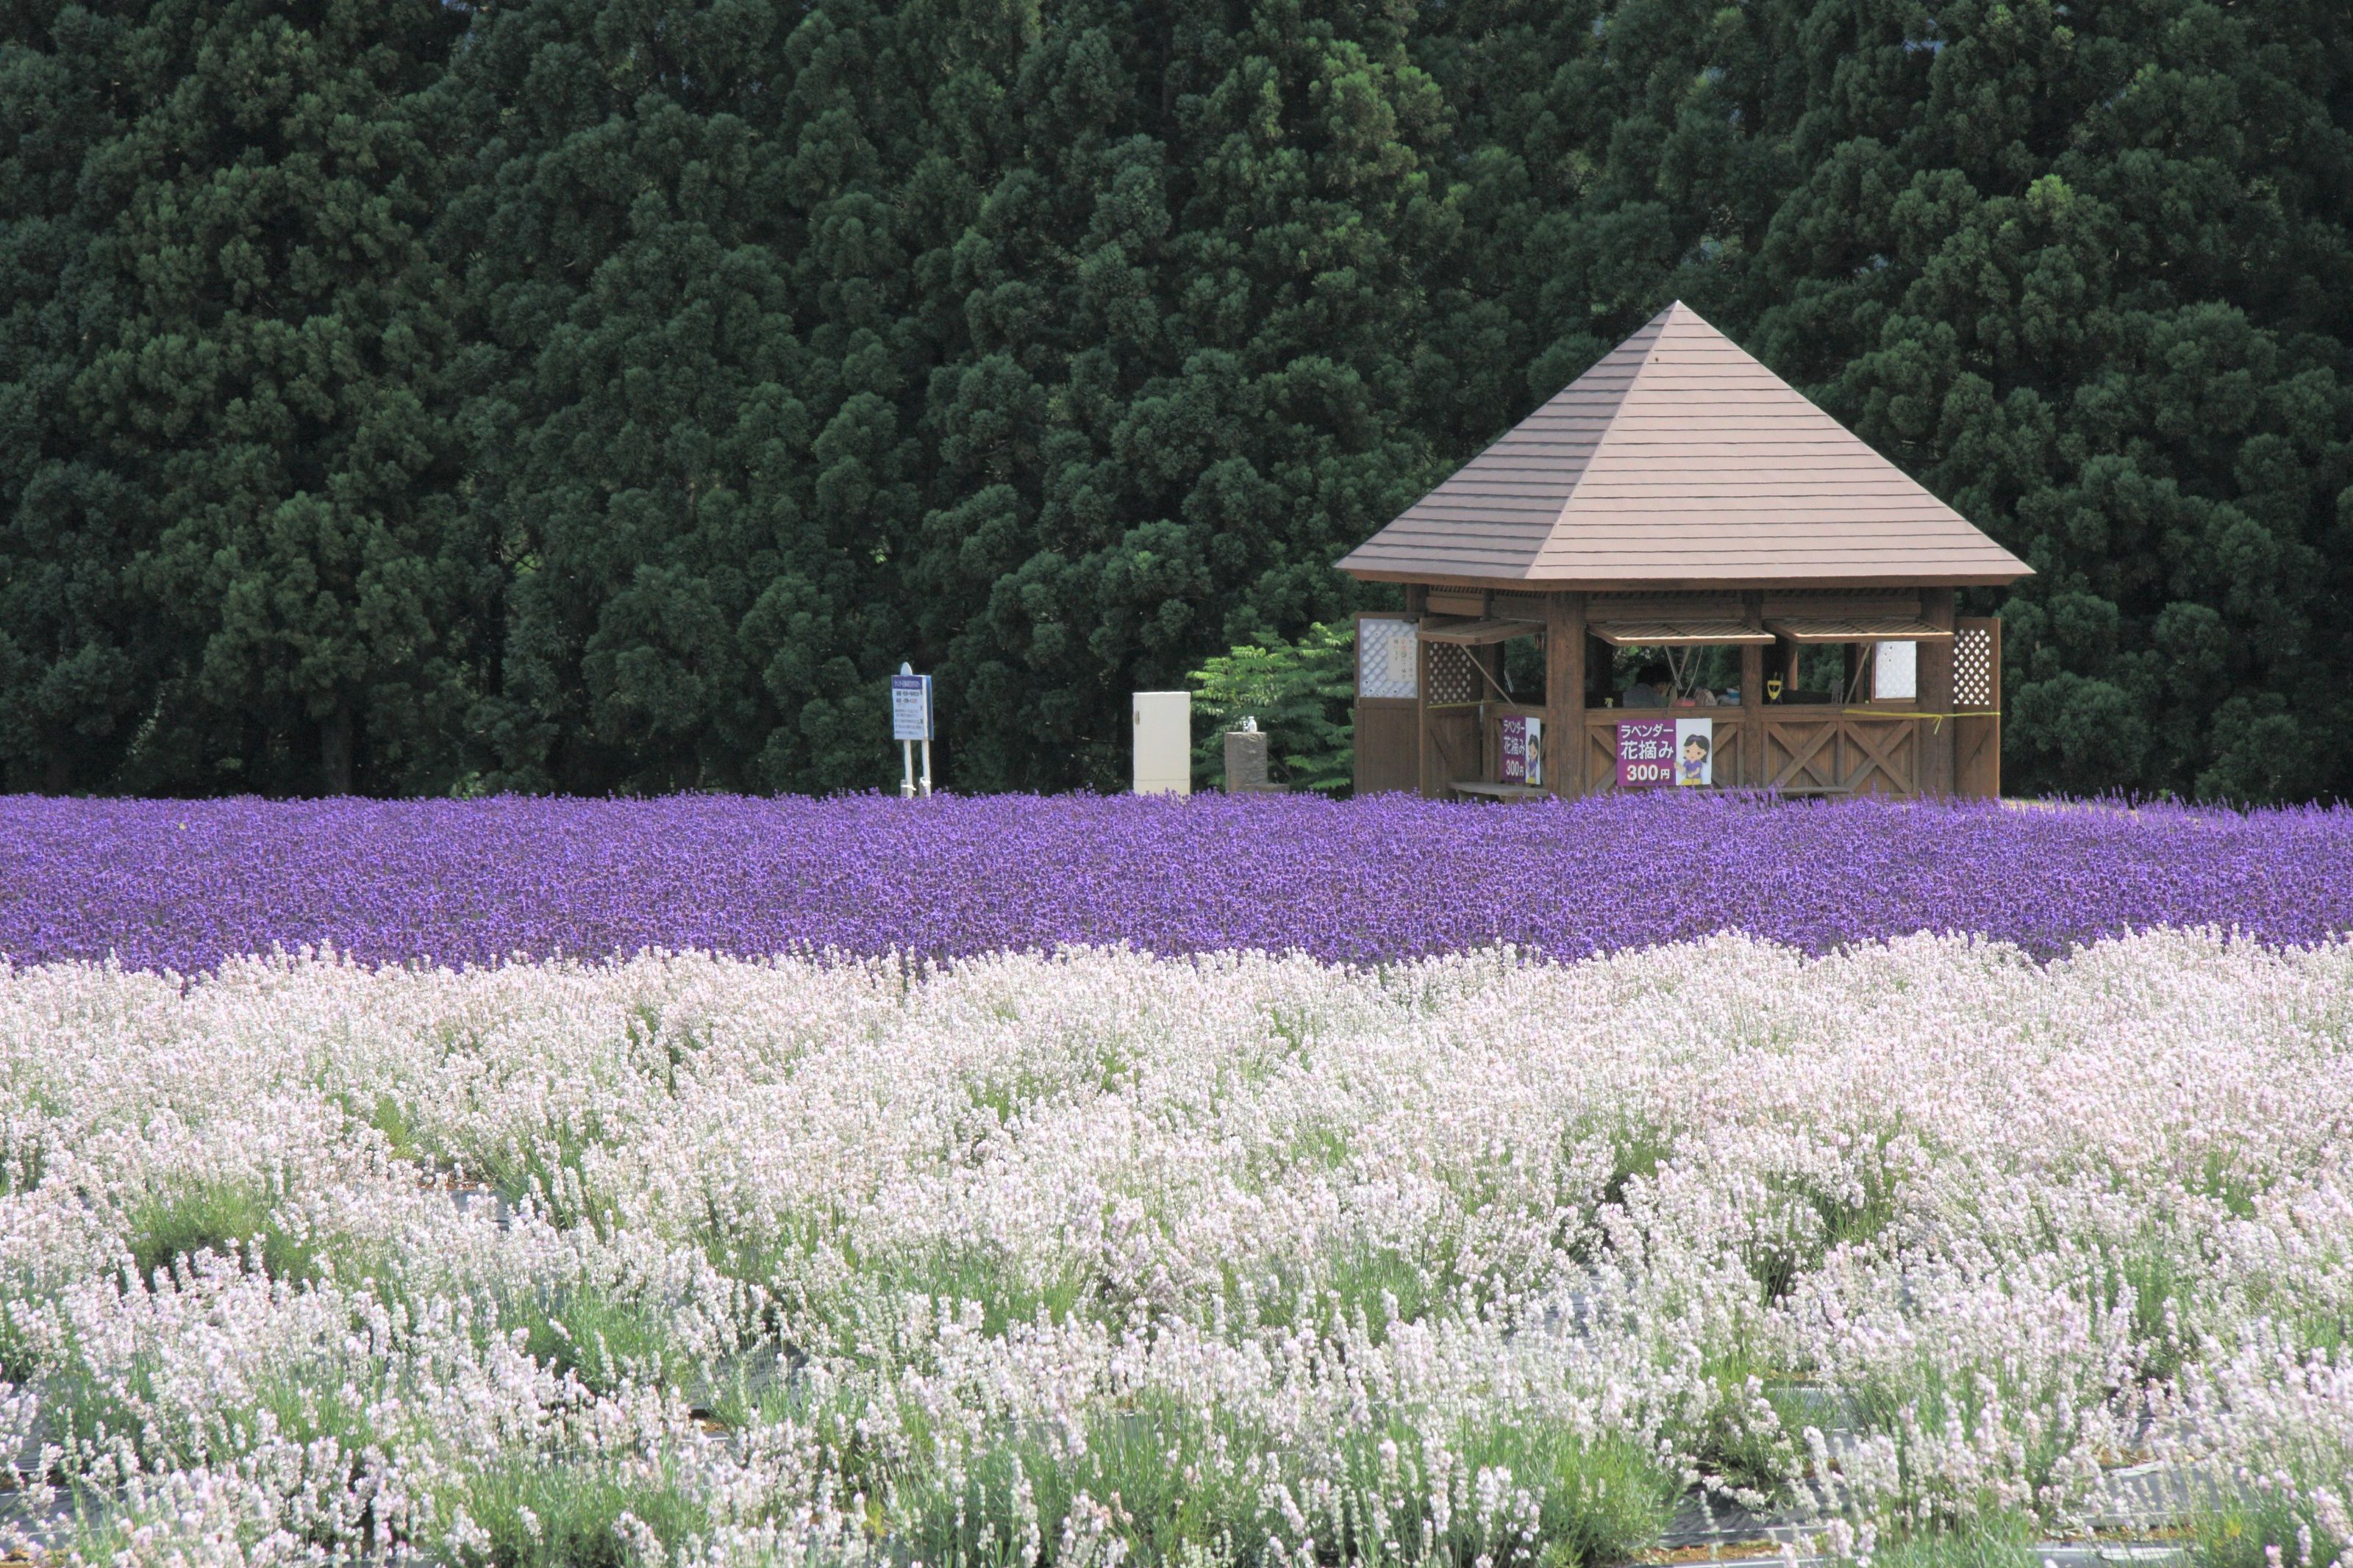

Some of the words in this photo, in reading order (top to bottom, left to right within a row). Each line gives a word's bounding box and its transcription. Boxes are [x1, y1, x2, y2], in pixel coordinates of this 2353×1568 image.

[1503, 720, 1526, 734] ラベンダー
[1621, 723, 1674, 739] ラベンダー
[1504, 736, 1526, 756] 花摘み
[1621, 740, 1674, 760] 花摘み
[1506, 759, 1524, 777] 300円
[1627, 764, 1671, 781] 300円
